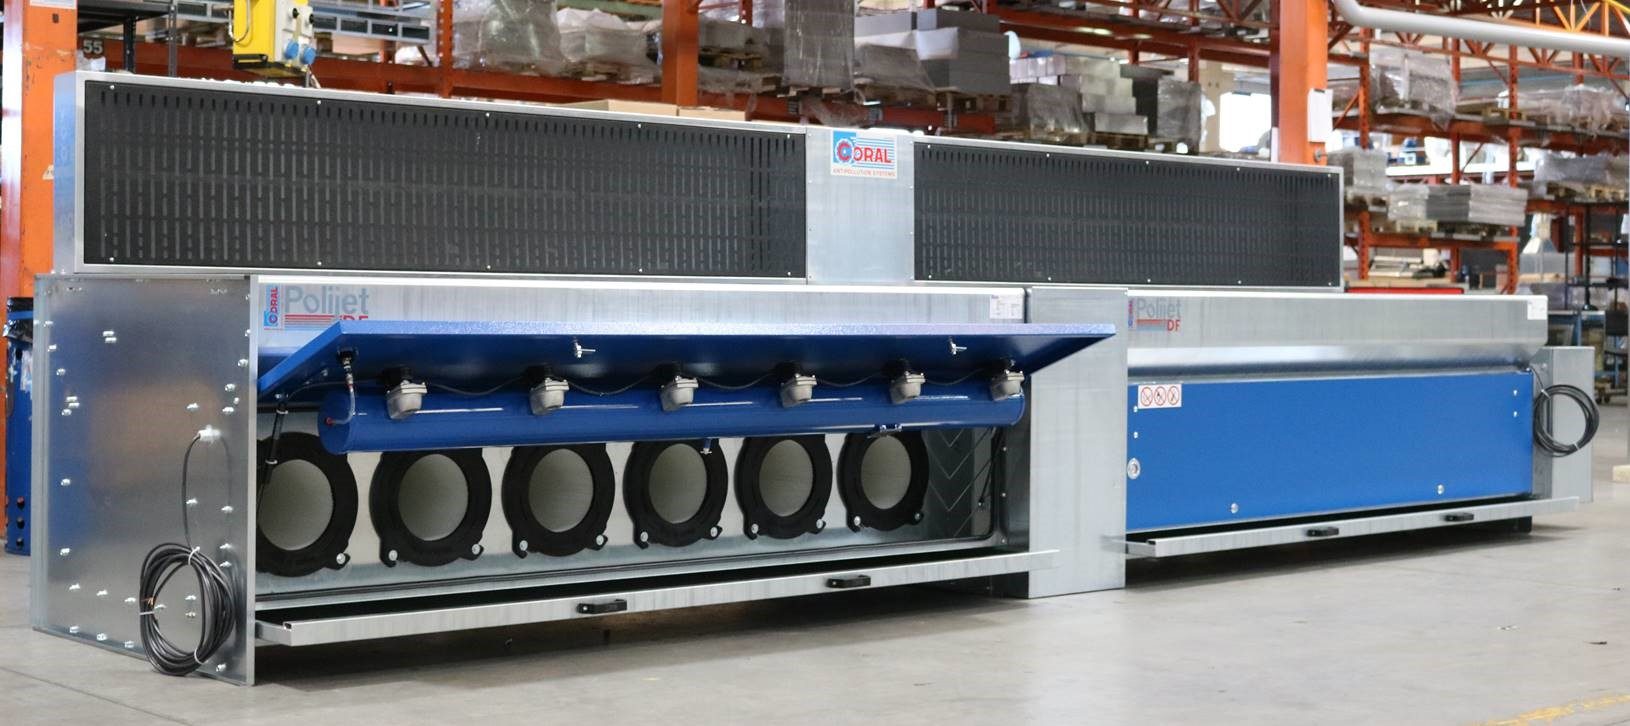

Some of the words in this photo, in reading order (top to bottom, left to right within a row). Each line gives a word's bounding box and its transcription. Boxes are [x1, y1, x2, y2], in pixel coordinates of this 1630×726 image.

[83, 40, 103, 54] 55
[837, 140, 892, 164] CORAL
[268, 286, 279, 324] CORAL
[284, 285, 369, 315] Polijet
[1167, 319, 1181, 332] DF
